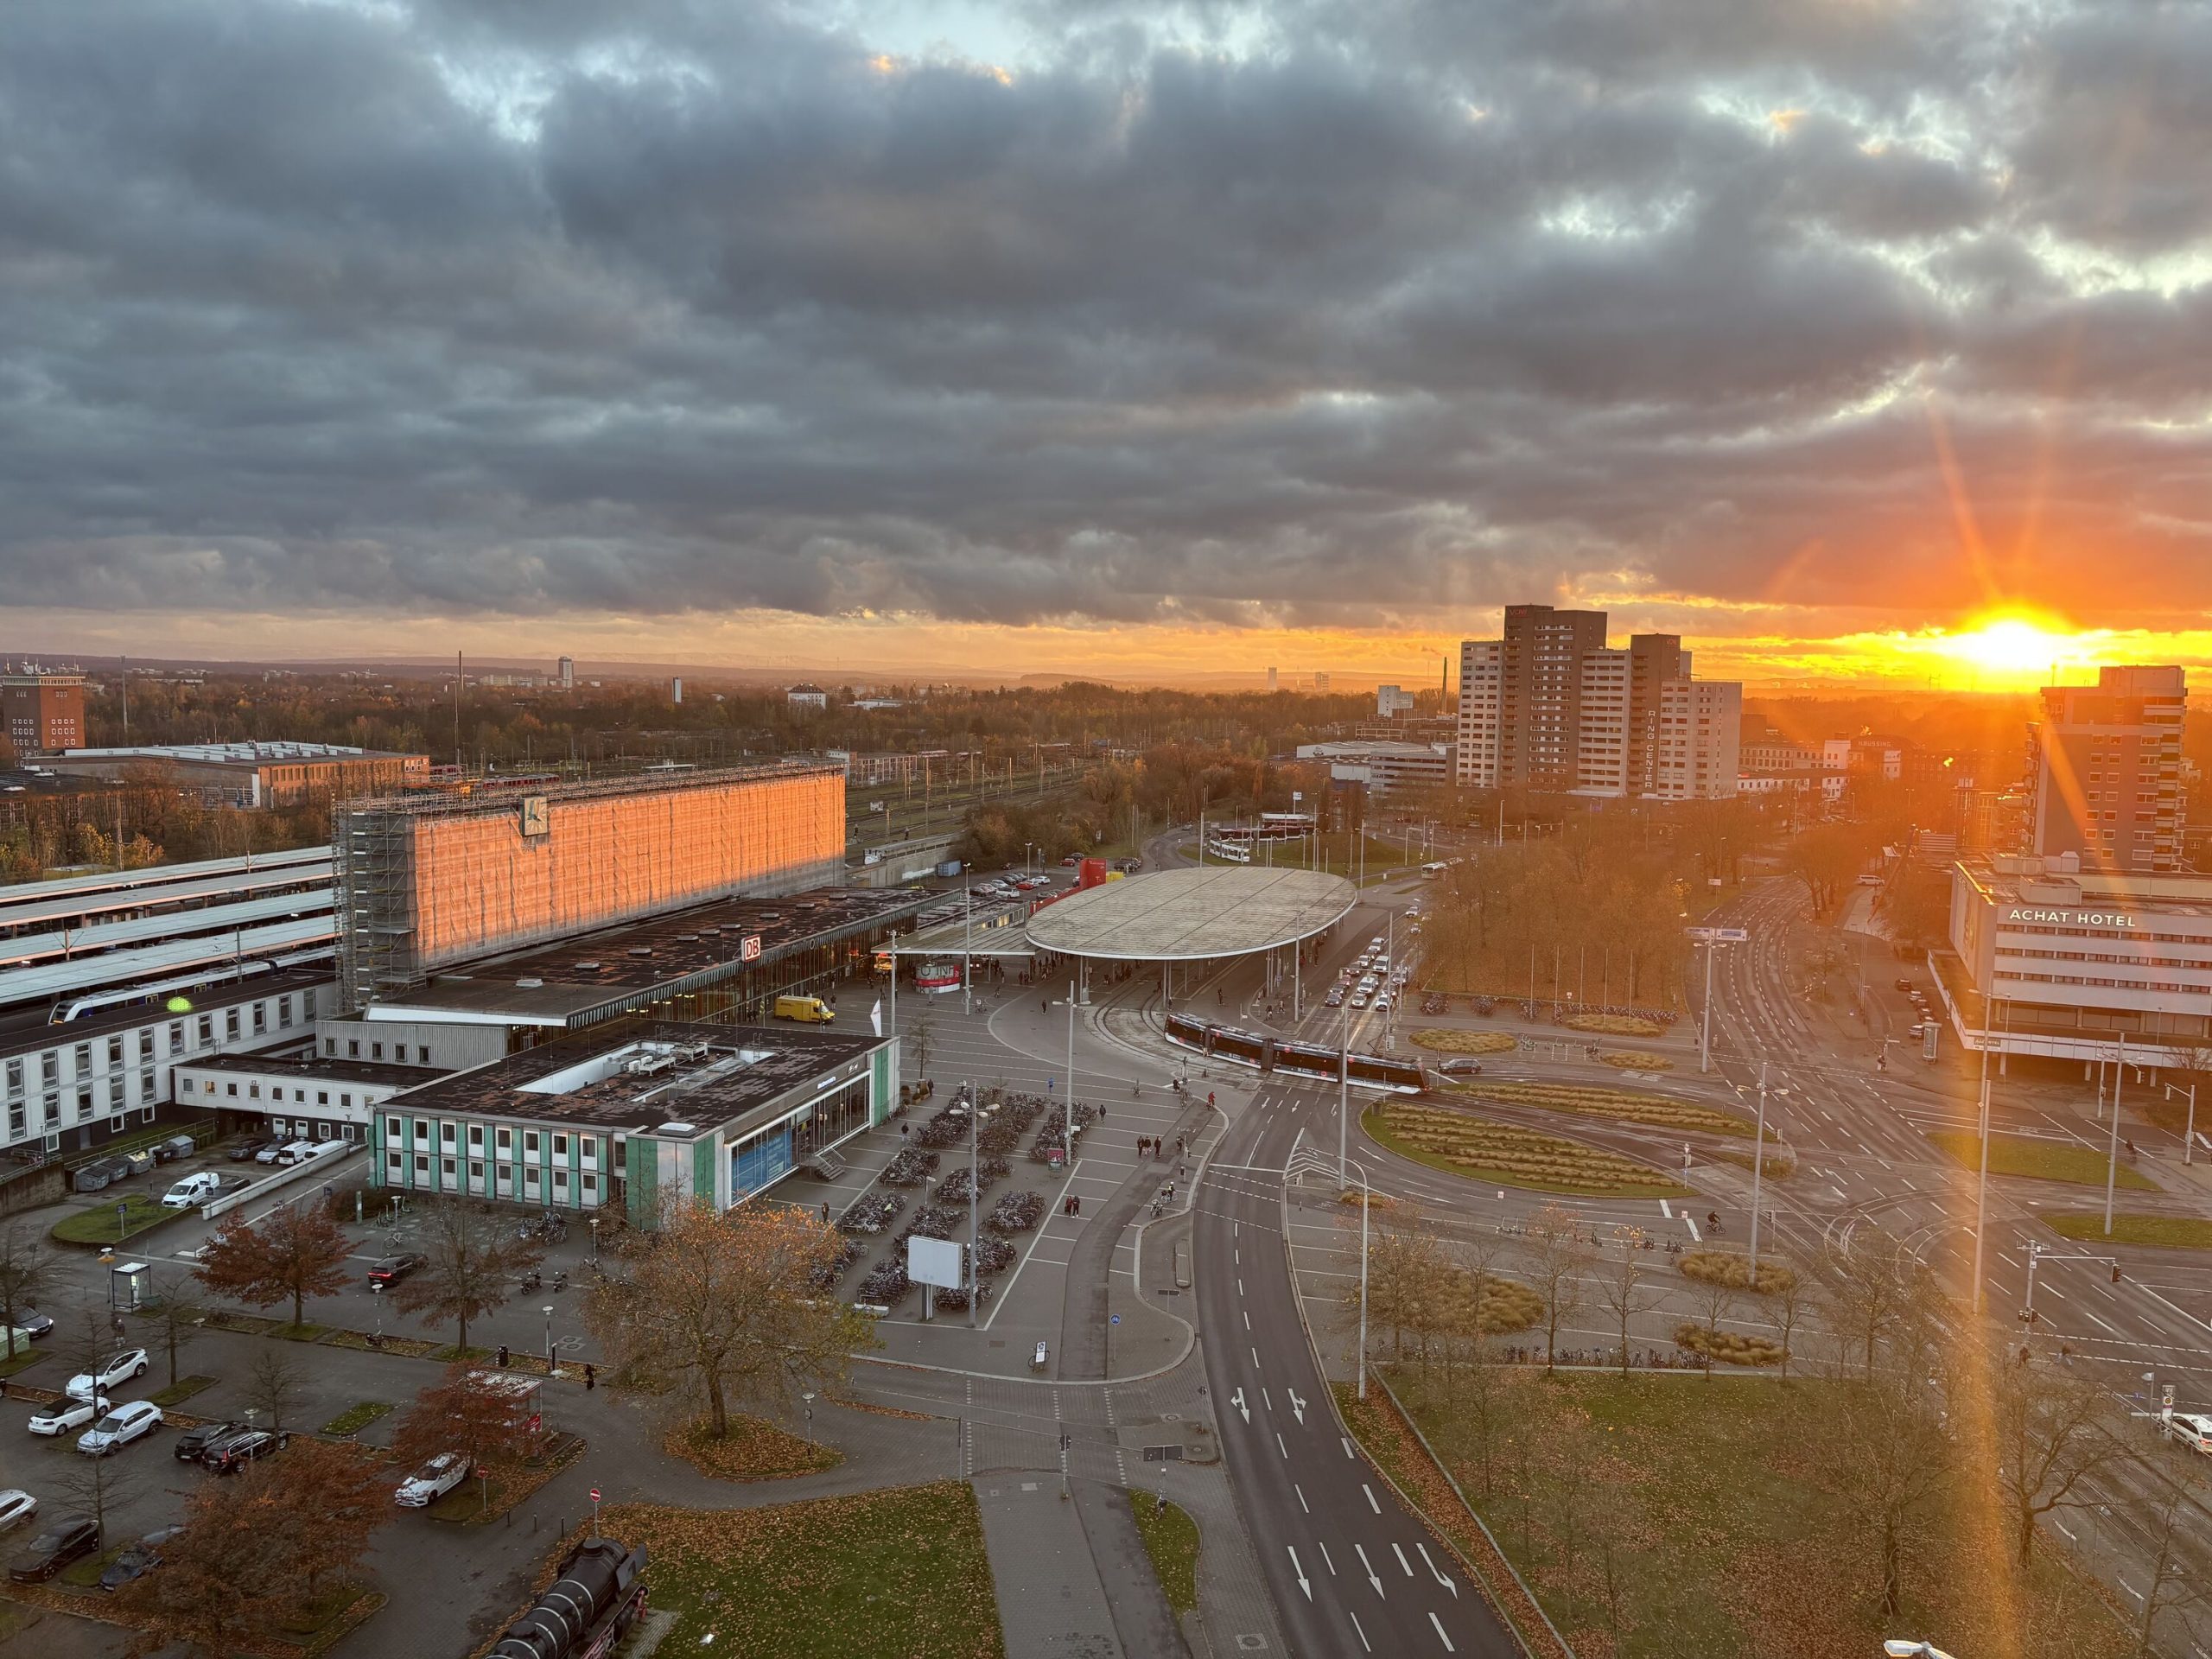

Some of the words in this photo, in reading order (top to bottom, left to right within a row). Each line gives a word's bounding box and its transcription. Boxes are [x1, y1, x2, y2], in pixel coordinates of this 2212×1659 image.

[1647, 710, 1656, 740] RING
[1644, 744, 1654, 789] CENTER
[2009, 909, 2069, 923] ACHAT
[2077, 913, 2136, 927] HOTEL
[747, 939, 760, 958] DB
